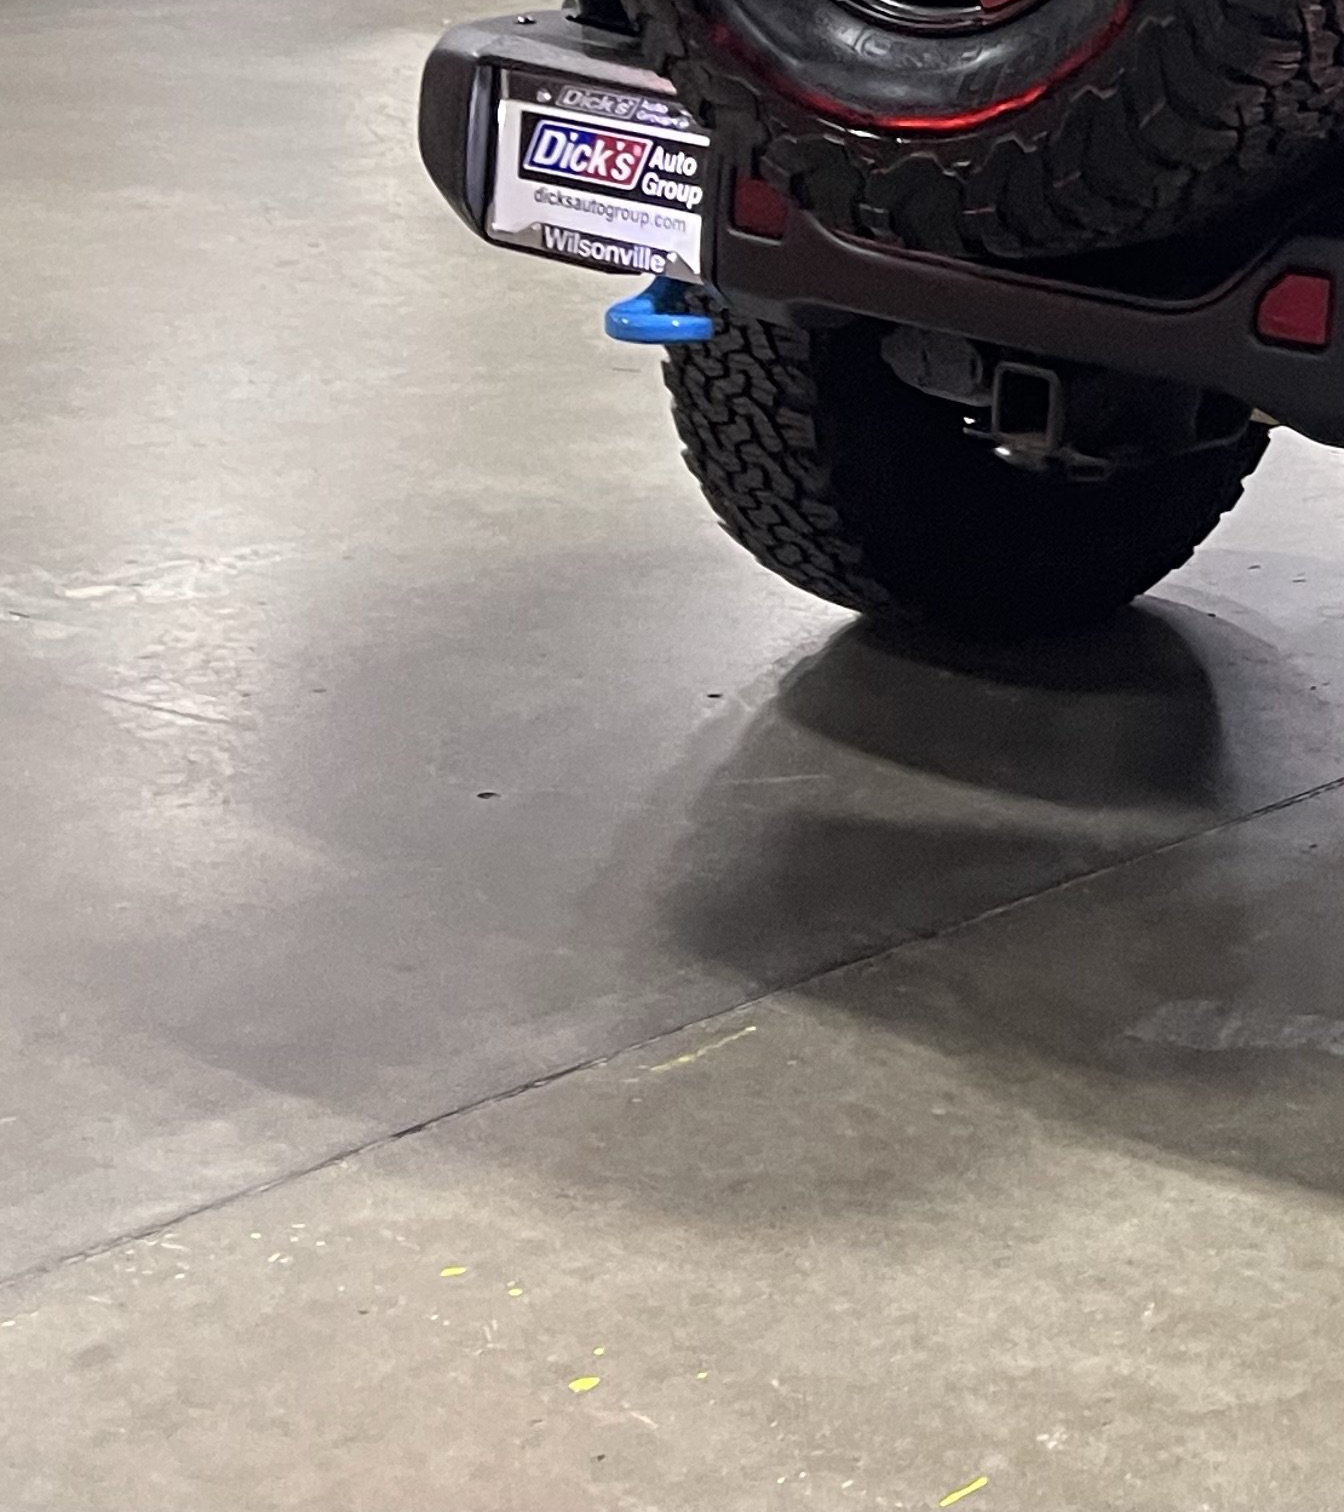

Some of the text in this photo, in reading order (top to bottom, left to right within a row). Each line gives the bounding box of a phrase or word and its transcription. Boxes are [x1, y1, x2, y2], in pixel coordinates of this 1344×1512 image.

[533, 129, 636, 181] Dick's
[648, 146, 698, 176] Auto
[534, 186, 687, 232] dicksautogroup.com
[641, 172, 703, 209] Group
[544, 226, 667, 273] Wilsonville
